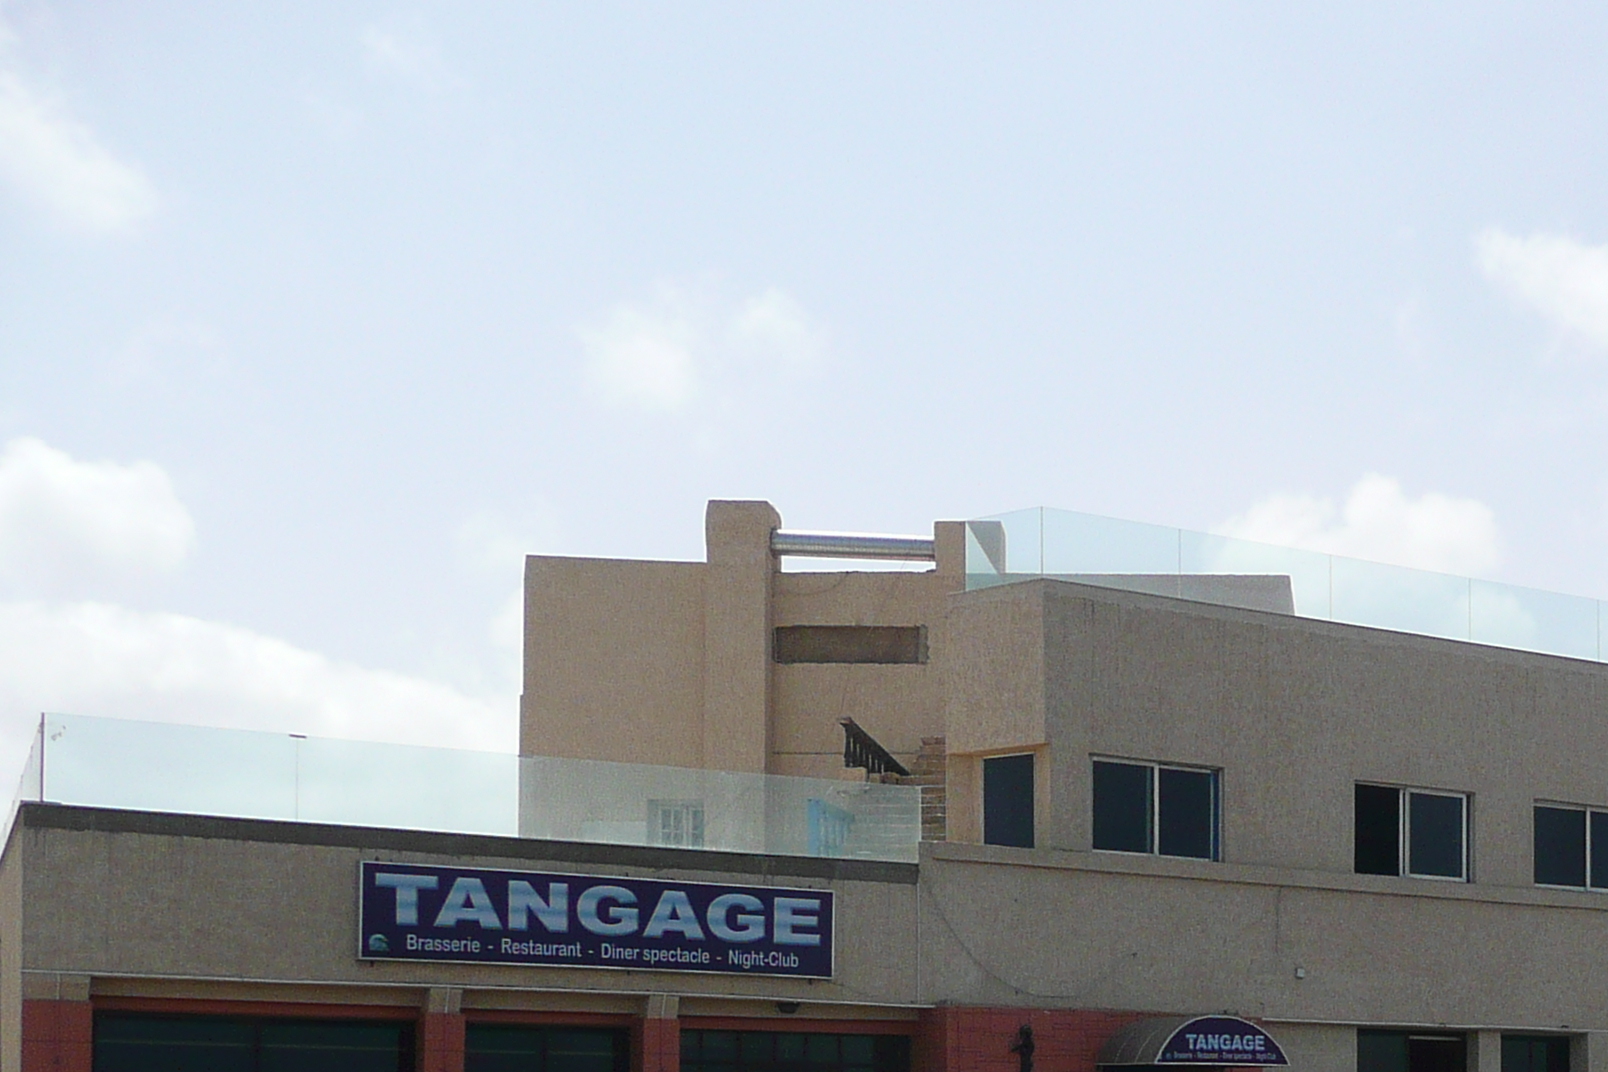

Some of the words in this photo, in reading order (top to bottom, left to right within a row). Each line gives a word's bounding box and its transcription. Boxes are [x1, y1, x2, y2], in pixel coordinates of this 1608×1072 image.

[375, 872, 821, 946] TANGAGE
[406, 933, 480, 953] Brasserie
[501, 938, 582, 957] Restaurant
[601, 943, 639, 960] Diner
[642, 947, 710, 964] spectacle
[728, 949, 799, 969] Night-Club
[1185, 1033, 1265, 1050] TANGAGE
